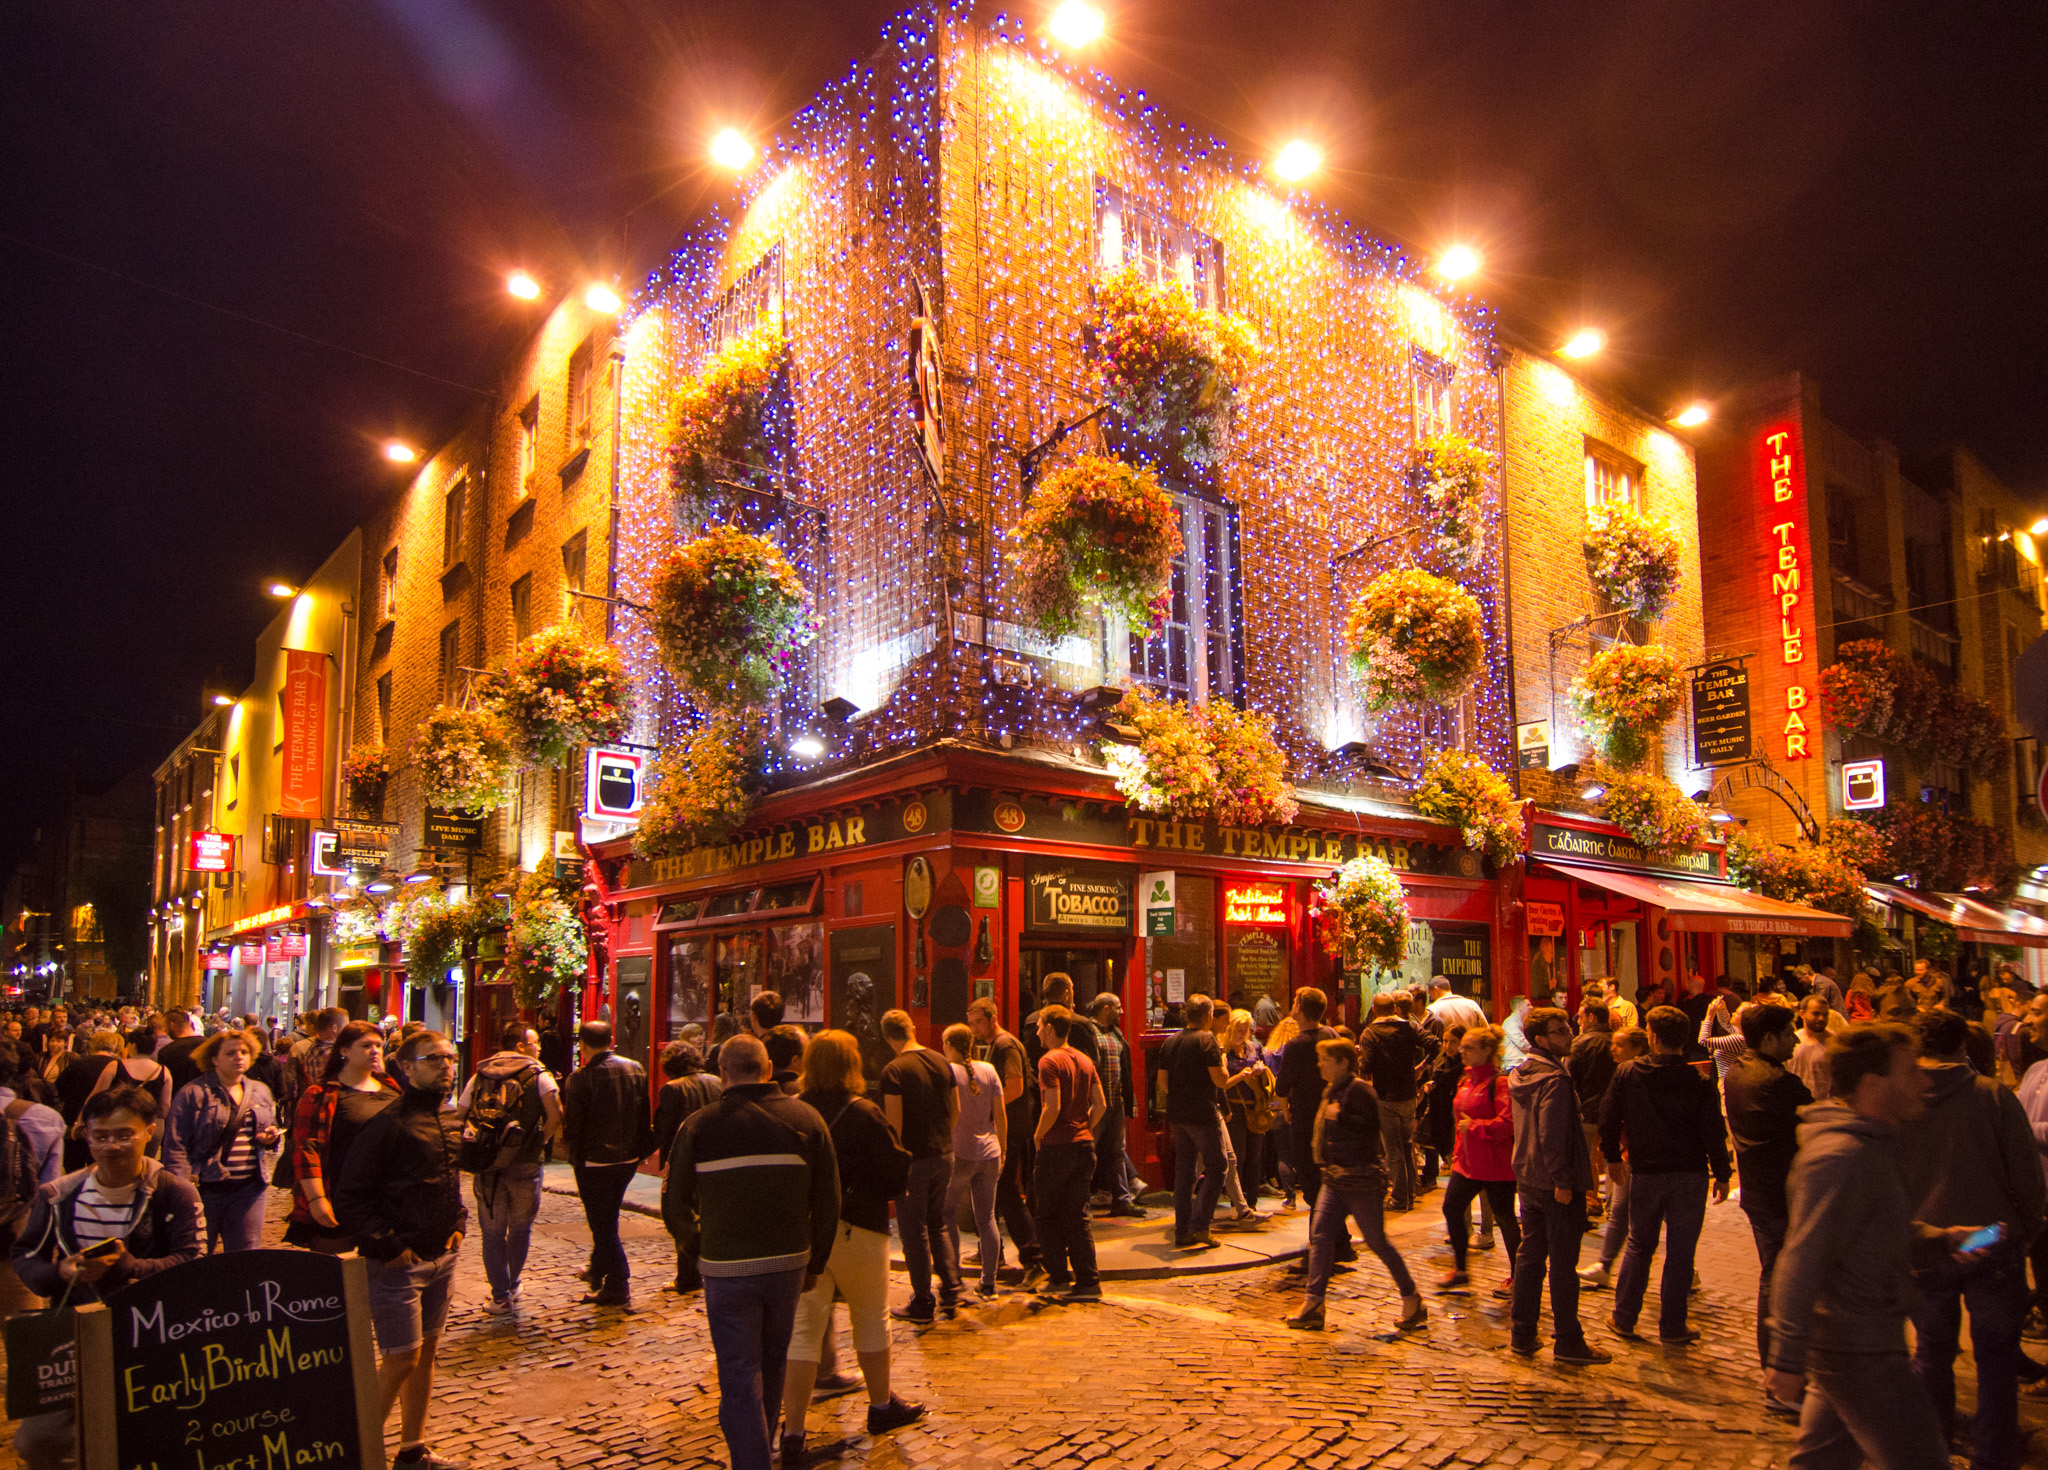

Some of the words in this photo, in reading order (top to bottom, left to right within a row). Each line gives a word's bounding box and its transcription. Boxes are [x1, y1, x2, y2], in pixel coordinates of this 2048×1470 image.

[1766, 431, 1793, 503] THE
[1772, 521, 1803, 664] TEMPLE
[1711, 669, 1728, 678] THE
[1695, 675, 1746, 692] TEMPLE
[294, 681, 306, 707] BAR
[1707, 689, 1735, 702] BAR
[1697, 715, 1716, 724] BEER
[1716, 710, 1746, 721] GARDEN
[1783, 686, 1807, 758] BAR
[291, 710, 305, 761] TEMPLE
[1700, 740, 1718, 748] LIVE
[1719, 736, 1745, 745] MUSIC
[307, 722, 317, 772] TRADING
[1710, 745, 1734, 754] DAILY
[290, 764, 303, 790] THE
[907, 807, 922, 827] 48
[1000, 807, 1019, 825] 48
[335, 822, 351, 831] THE
[383, 826, 399, 834] BAR
[450, 826, 477, 834] MUSIC
[653, 856, 695, 882] THE
[699, 831, 796, 873] TEMPLE
[807, 816, 866, 853] BAR
[1129, 817, 1205, 851] THE
[1218, 826, 1343, 864] TEMPLE
[1356, 842, 1410, 870] BAR
[341, 848, 391, 858] DISTILLERY
[352, 856, 381, 865] STORE
[1031, 867, 1075, 888] Importers
[1069, 883, 1087, 893] FINE
[1086, 884, 1118, 895] SMOKING
[1226, 888, 1283, 904] Traditional
[1043, 886, 1119, 920] TOBACCO
[1528, 904, 1539, 914] Beer
[1059, 916, 1089, 925] Always
[1102, 917, 1126, 926] Stock
[1225, 905, 1252, 921] Irish
[1256, 906, 1286, 922] Music
[1533, 925, 1544, 934] Area
[1727, 919, 1744, 931] THE
[1745, 920, 1775, 932] TEMPLE
[1775, 921, 1791, 933] BAR
[1239, 931, 1265, 947] TEMPLE
[1265, 934, 1278, 948] BAR
[1464, 940, 1482, 957] THE
[1442, 957, 1482, 976] EMPEROR
[1472, 978, 1483, 994] OF
[130, 1300, 240, 1348] Mexico
[243, 1289, 261, 1323] to
[258, 1280, 346, 1322] Rome
[124, 1353, 206, 1412] Early
[202, 1343, 271, 1390] Bird
[267, 1326, 344, 1379] Menu
[185, 1419, 204, 1446] 2
[211, 1408, 296, 1437] course
[262, 1430, 344, 1470] Main
